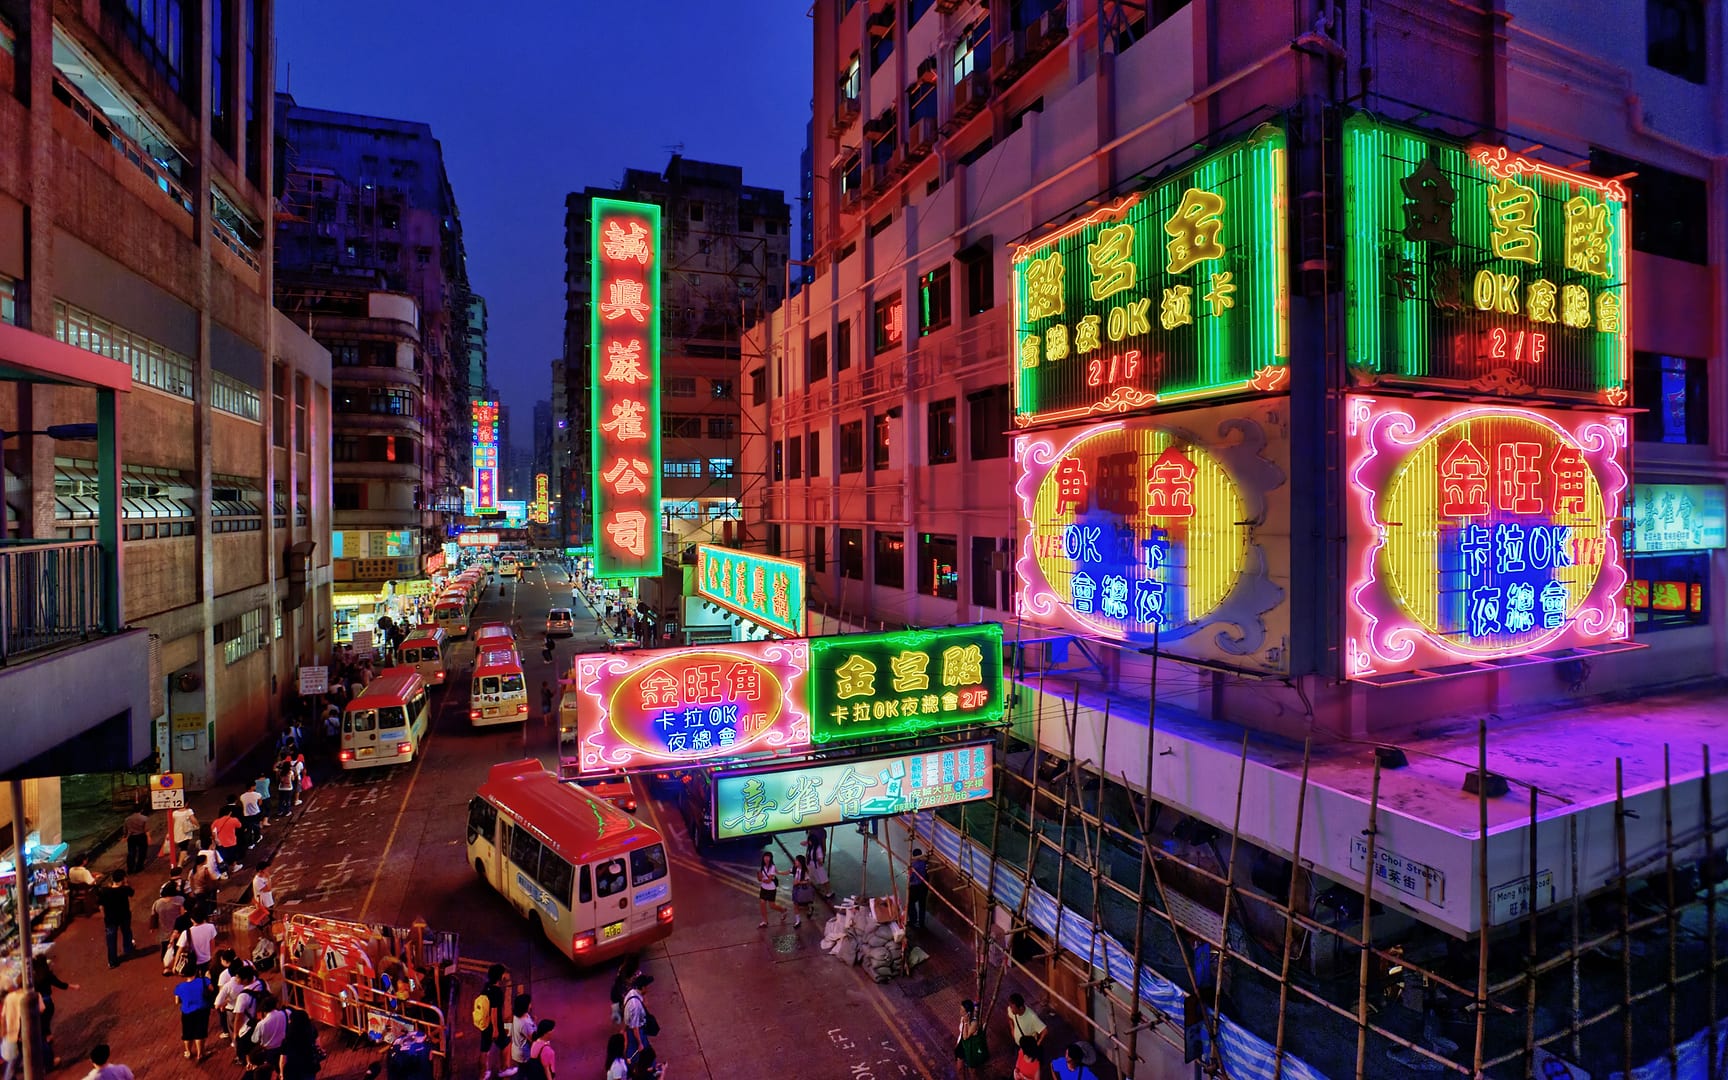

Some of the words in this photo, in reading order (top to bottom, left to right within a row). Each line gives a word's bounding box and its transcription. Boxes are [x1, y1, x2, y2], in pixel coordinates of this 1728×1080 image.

[1492, 328, 1545, 362] 2/F
[1089, 350, 1140, 385] 2/F
[1442, 439, 1588, 516] 金旺角
[1471, 580, 1569, 636] 夜總會
[640, 662, 761, 711] 金旺角
[961, 690, 989, 709] 2/F
[742, 713, 768, 732] 1/F
[667, 727, 737, 753] 夜總會
[722, 766, 878, 832] 喜雀會
[943, 790, 967, 803] 2766
[1356, 842, 1378, 859] Tug
[1381, 853, 1402, 867] Choi
[1406, 863, 1437, 882] Street
[1375, 863, 1416, 890] 通菜街
[1497, 891, 1516, 902] Mong
